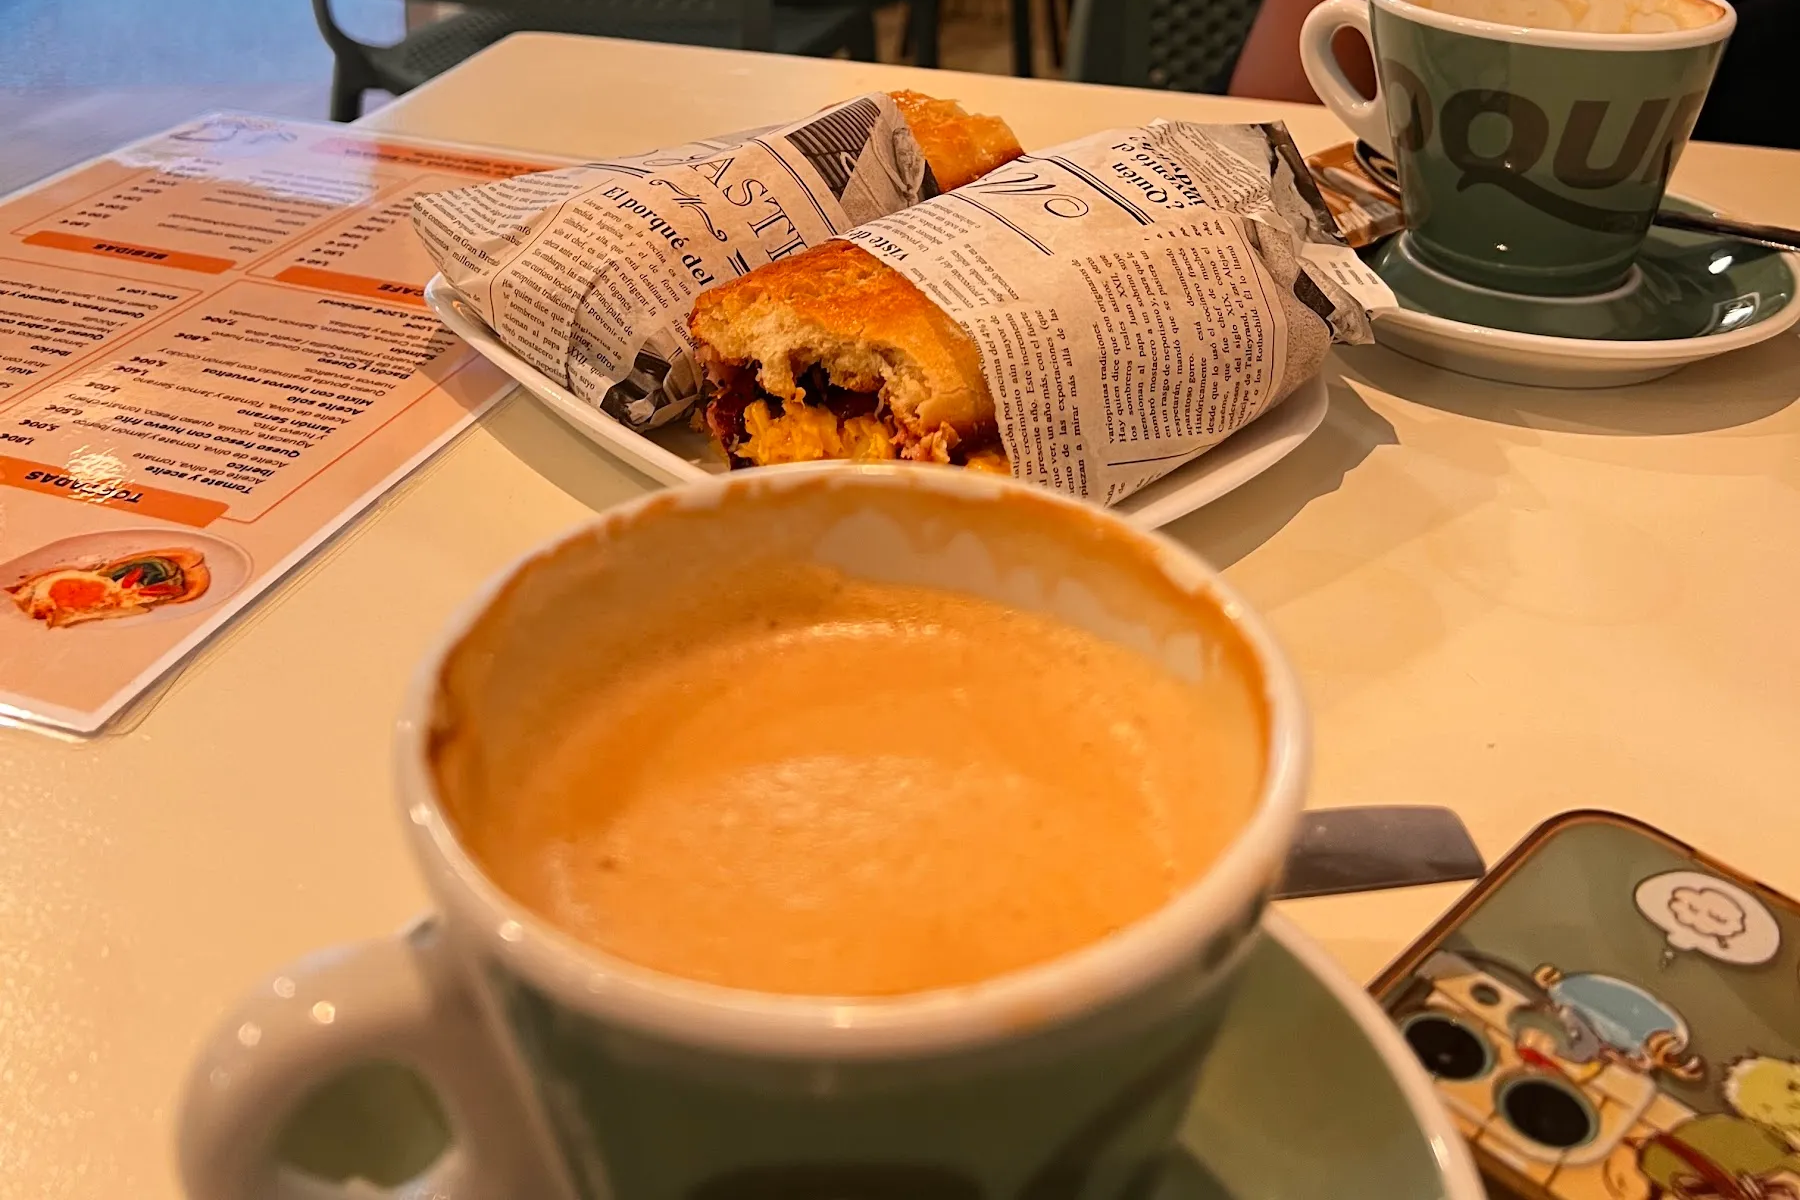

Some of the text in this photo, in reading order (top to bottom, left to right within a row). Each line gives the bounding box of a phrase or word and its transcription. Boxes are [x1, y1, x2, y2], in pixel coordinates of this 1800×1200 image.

[602, 186, 715, 287] El porqué del
[460, 238, 478, 255] Gran
[602, 211, 622, 223] gorro
[635, 230, 644, 238] la
[646, 240, 666, 264] cocina
[668, 268, 676, 278] es
[678, 281, 692, 296] una
[1086, 257, 1102, 274] otros
[598, 270, 610, 284] los
[624, 256, 669, 309] está destinado
[648, 264, 658, 274] de
[661, 279, 680, 302] forma
[1178, 248, 1212, 323] cocinero francés
[619, 272, 656, 317] refrigerar la
[1079, 268, 1107, 313] originarios
[591, 289, 633, 337] principales de
[1126, 304, 1138, 326] Juan
[1020, 312, 1037, 337] fuerte
[1104, 316, 1114, 333] son
[1006, 313, 1030, 366] incremento
[1030, 340, 1040, 349] el
[1119, 321, 1132, 350] reales
[1136, 333, 1147, 357] papa
[1166, 248, 1207, 435] Históricamente está documentado
[1110, 336, 1121, 356] que
[5, 366, 38, 376] Atún
[317, 358, 358, 369] Queso
[1036, 352, 1045, 371] con
[1111, 359, 1120, 382] dice
[1137, 365, 1145, 374] al
[202, 368, 261, 383] revueltos
[370, 367, 411, 380] Bacón
[980, 324, 1013, 420] por encima del 4%
[1048, 308, 1081, 436] mirar más allá de las
[261, 380, 309, 394] huevos
[1025, 370, 1035, 394] Este
[1034, 310, 1070, 458] de las exportaciones (que
[1125, 360, 1134, 416] sombreros
[286, 396, 317, 405] solo
[310, 389, 335, 398] con
[336, 394, 374, 406] Mixto
[990, 315, 1032, 476] un crecimiento aún mayor de
[1114, 386, 1124, 416] quien
[237, 409, 289, 424] Serrano
[317, 402, 365, 416] Aceite
[1043, 402, 1052, 423] año
[1102, 383, 1115, 444] variopintas
[1138, 382, 1150, 440] mencionan
[114, 415, 144, 426] frito
[143, 421, 186, 434] huevo
[290, 419, 337, 434] Jamón
[186, 429, 212, 439] con
[278, 428, 316, 440] huevo
[1047, 426, 1054, 440] un
[1118, 420, 1126, 443] Hay
[1130, 425, 1138, 442] los
[18, 419, 276, 477] Iberico 5,00€
[213, 436, 256, 449] fresco
[256, 445, 300, 458] Queso
[1034, 427, 1048, 474] presente
[132, 452, 176, 466] tomate
[144, 466, 188, 478] aceite
[208, 468, 226, 476] de
[226, 472, 266, 485] Aceite
[1052, 467, 1062, 488] que
[200, 478, 253, 494] Tomate
